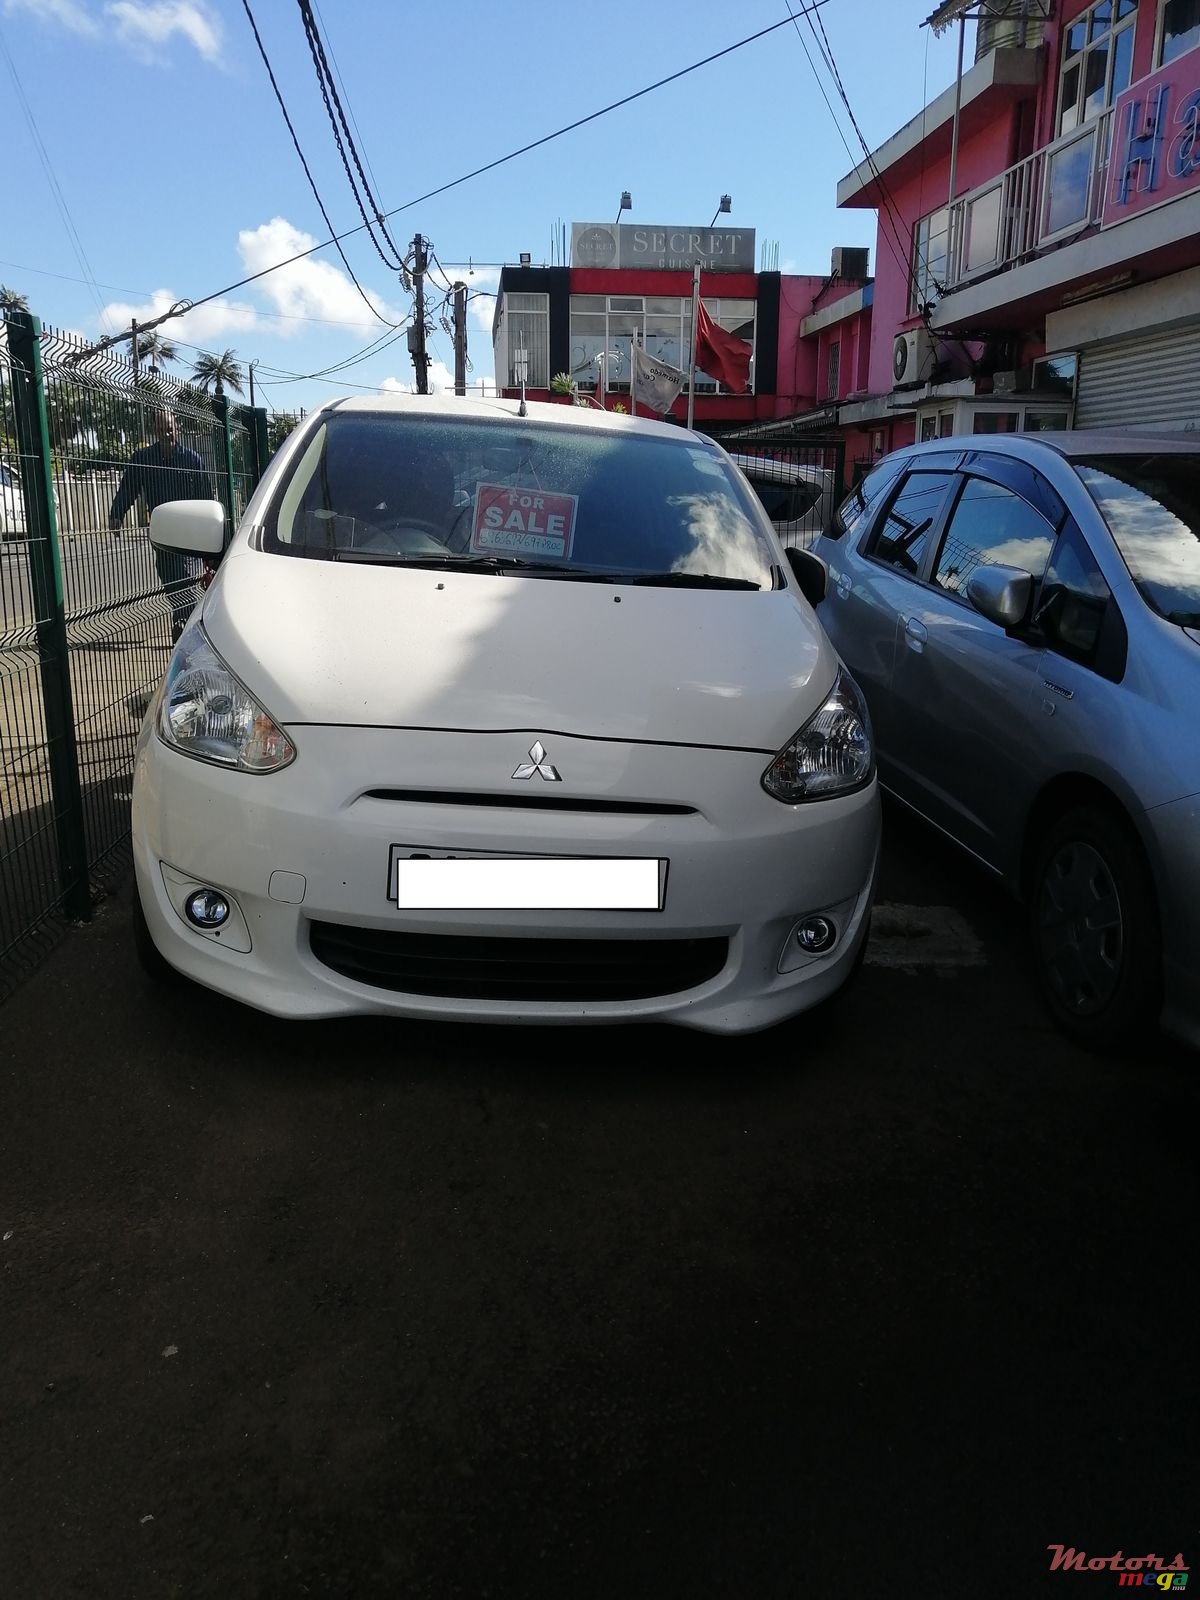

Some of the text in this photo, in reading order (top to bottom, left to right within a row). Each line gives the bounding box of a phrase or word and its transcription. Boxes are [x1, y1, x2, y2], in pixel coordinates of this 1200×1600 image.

[633, 231, 742, 256] SECRET
[658, 258, 717, 270] CUISNE
[509, 495, 544, 509] FOR
[485, 506, 565, 535] SALE
